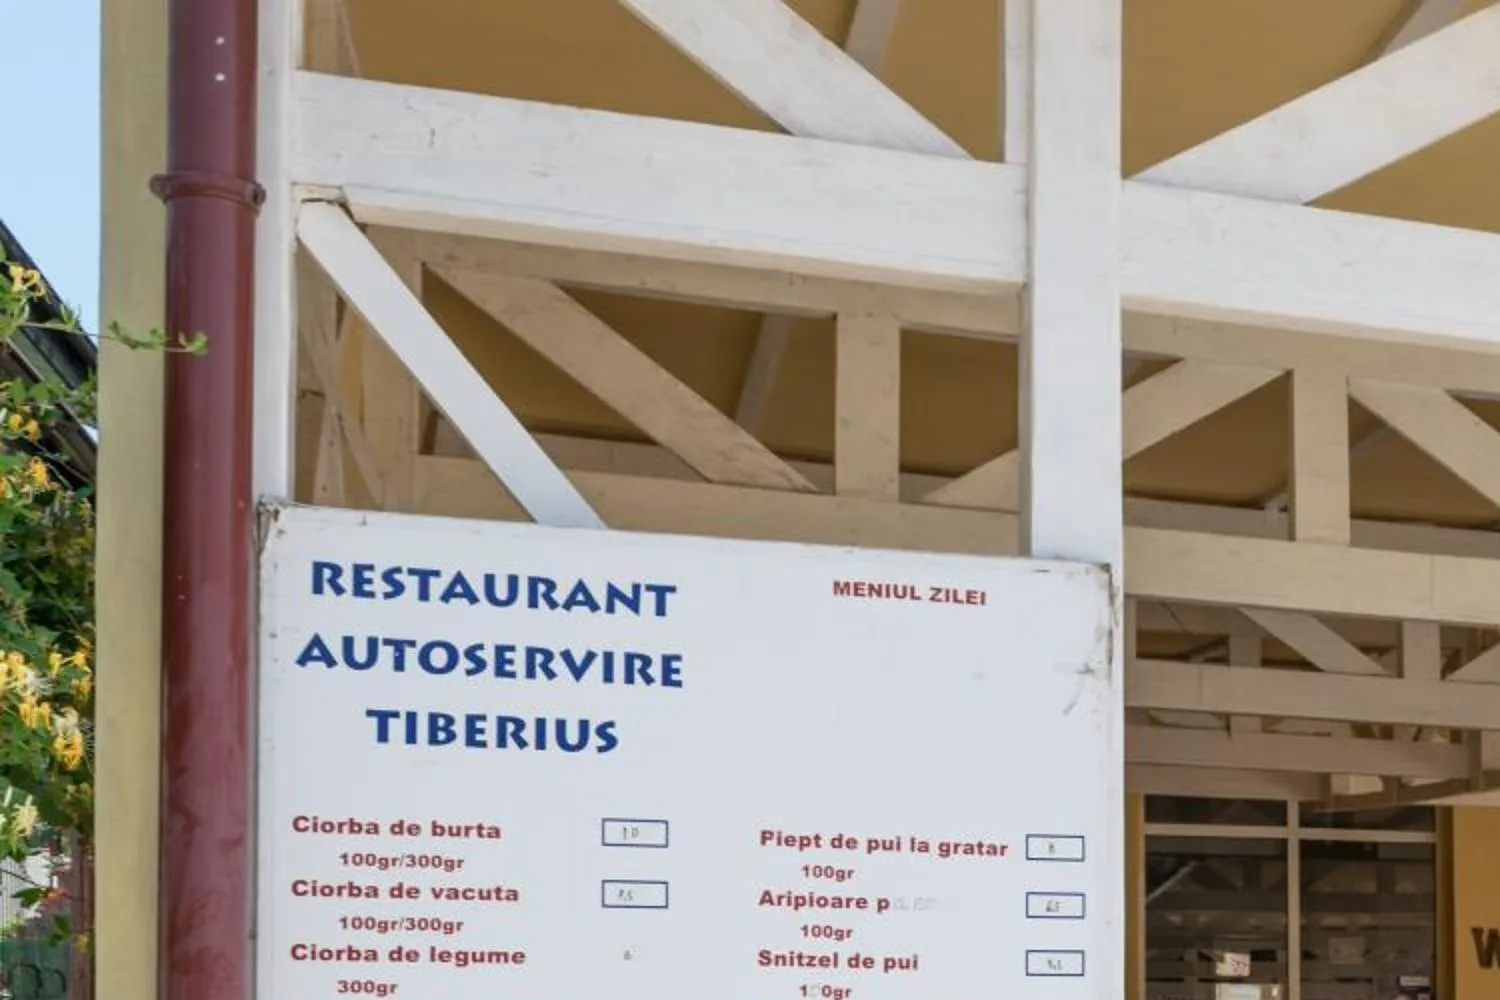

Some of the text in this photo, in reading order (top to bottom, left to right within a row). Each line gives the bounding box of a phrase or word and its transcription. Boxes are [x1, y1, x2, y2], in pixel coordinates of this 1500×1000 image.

[311, 560, 678, 618] RESTAURANT
[832, 580, 987, 606] MENIUL ZILEI
[295, 632, 683, 689] AUTOSERVIRE
[364, 708, 619, 754] TIBERIUS
[291, 815, 502, 840] Ciorba de burta
[759, 829, 1009, 859] Piept de pui la gratar
[337, 852, 465, 873] 100gr/300gr
[801, 864, 855, 883] 100gr
[290, 879, 519, 902] Ciorba de vacuta
[758, 889, 869, 912] Aripioare
[337, 915, 465, 936] 100gr/300gr
[800, 924, 853, 942] 100gr
[289, 943, 527, 968] Ciorba de legume
[757, 949, 918, 974] Snitzel de pui
[336, 979, 398, 998] 300gr
